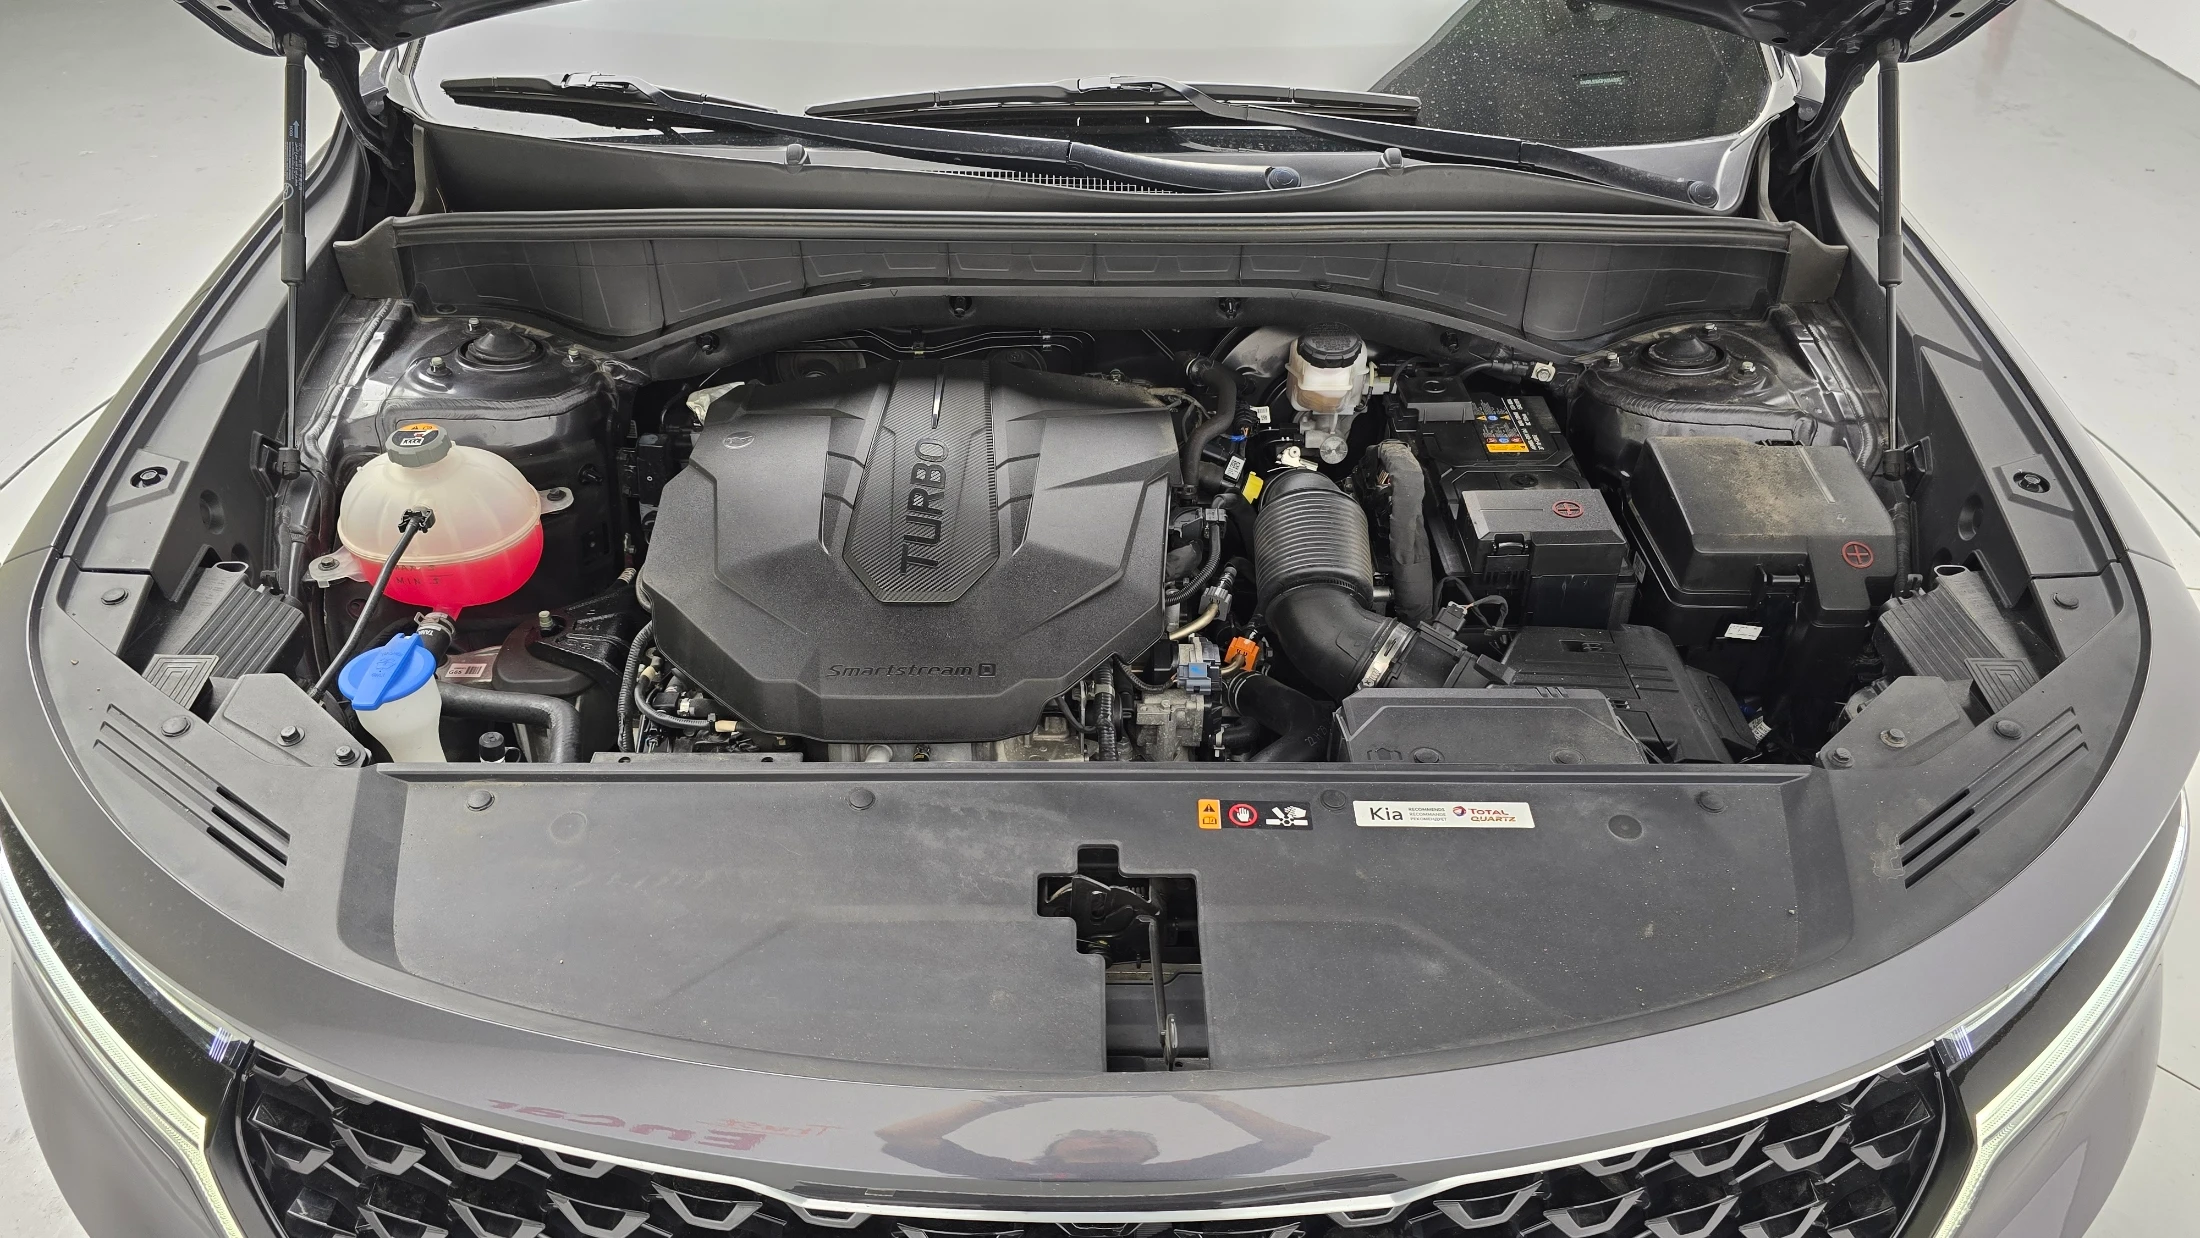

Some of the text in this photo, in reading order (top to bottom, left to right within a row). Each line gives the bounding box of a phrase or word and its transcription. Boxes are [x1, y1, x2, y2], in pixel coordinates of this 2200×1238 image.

[900, 437, 950, 576] TURBO
[825, 664, 973, 677] Smartstream
[1369, 807, 1404, 821] Kia
